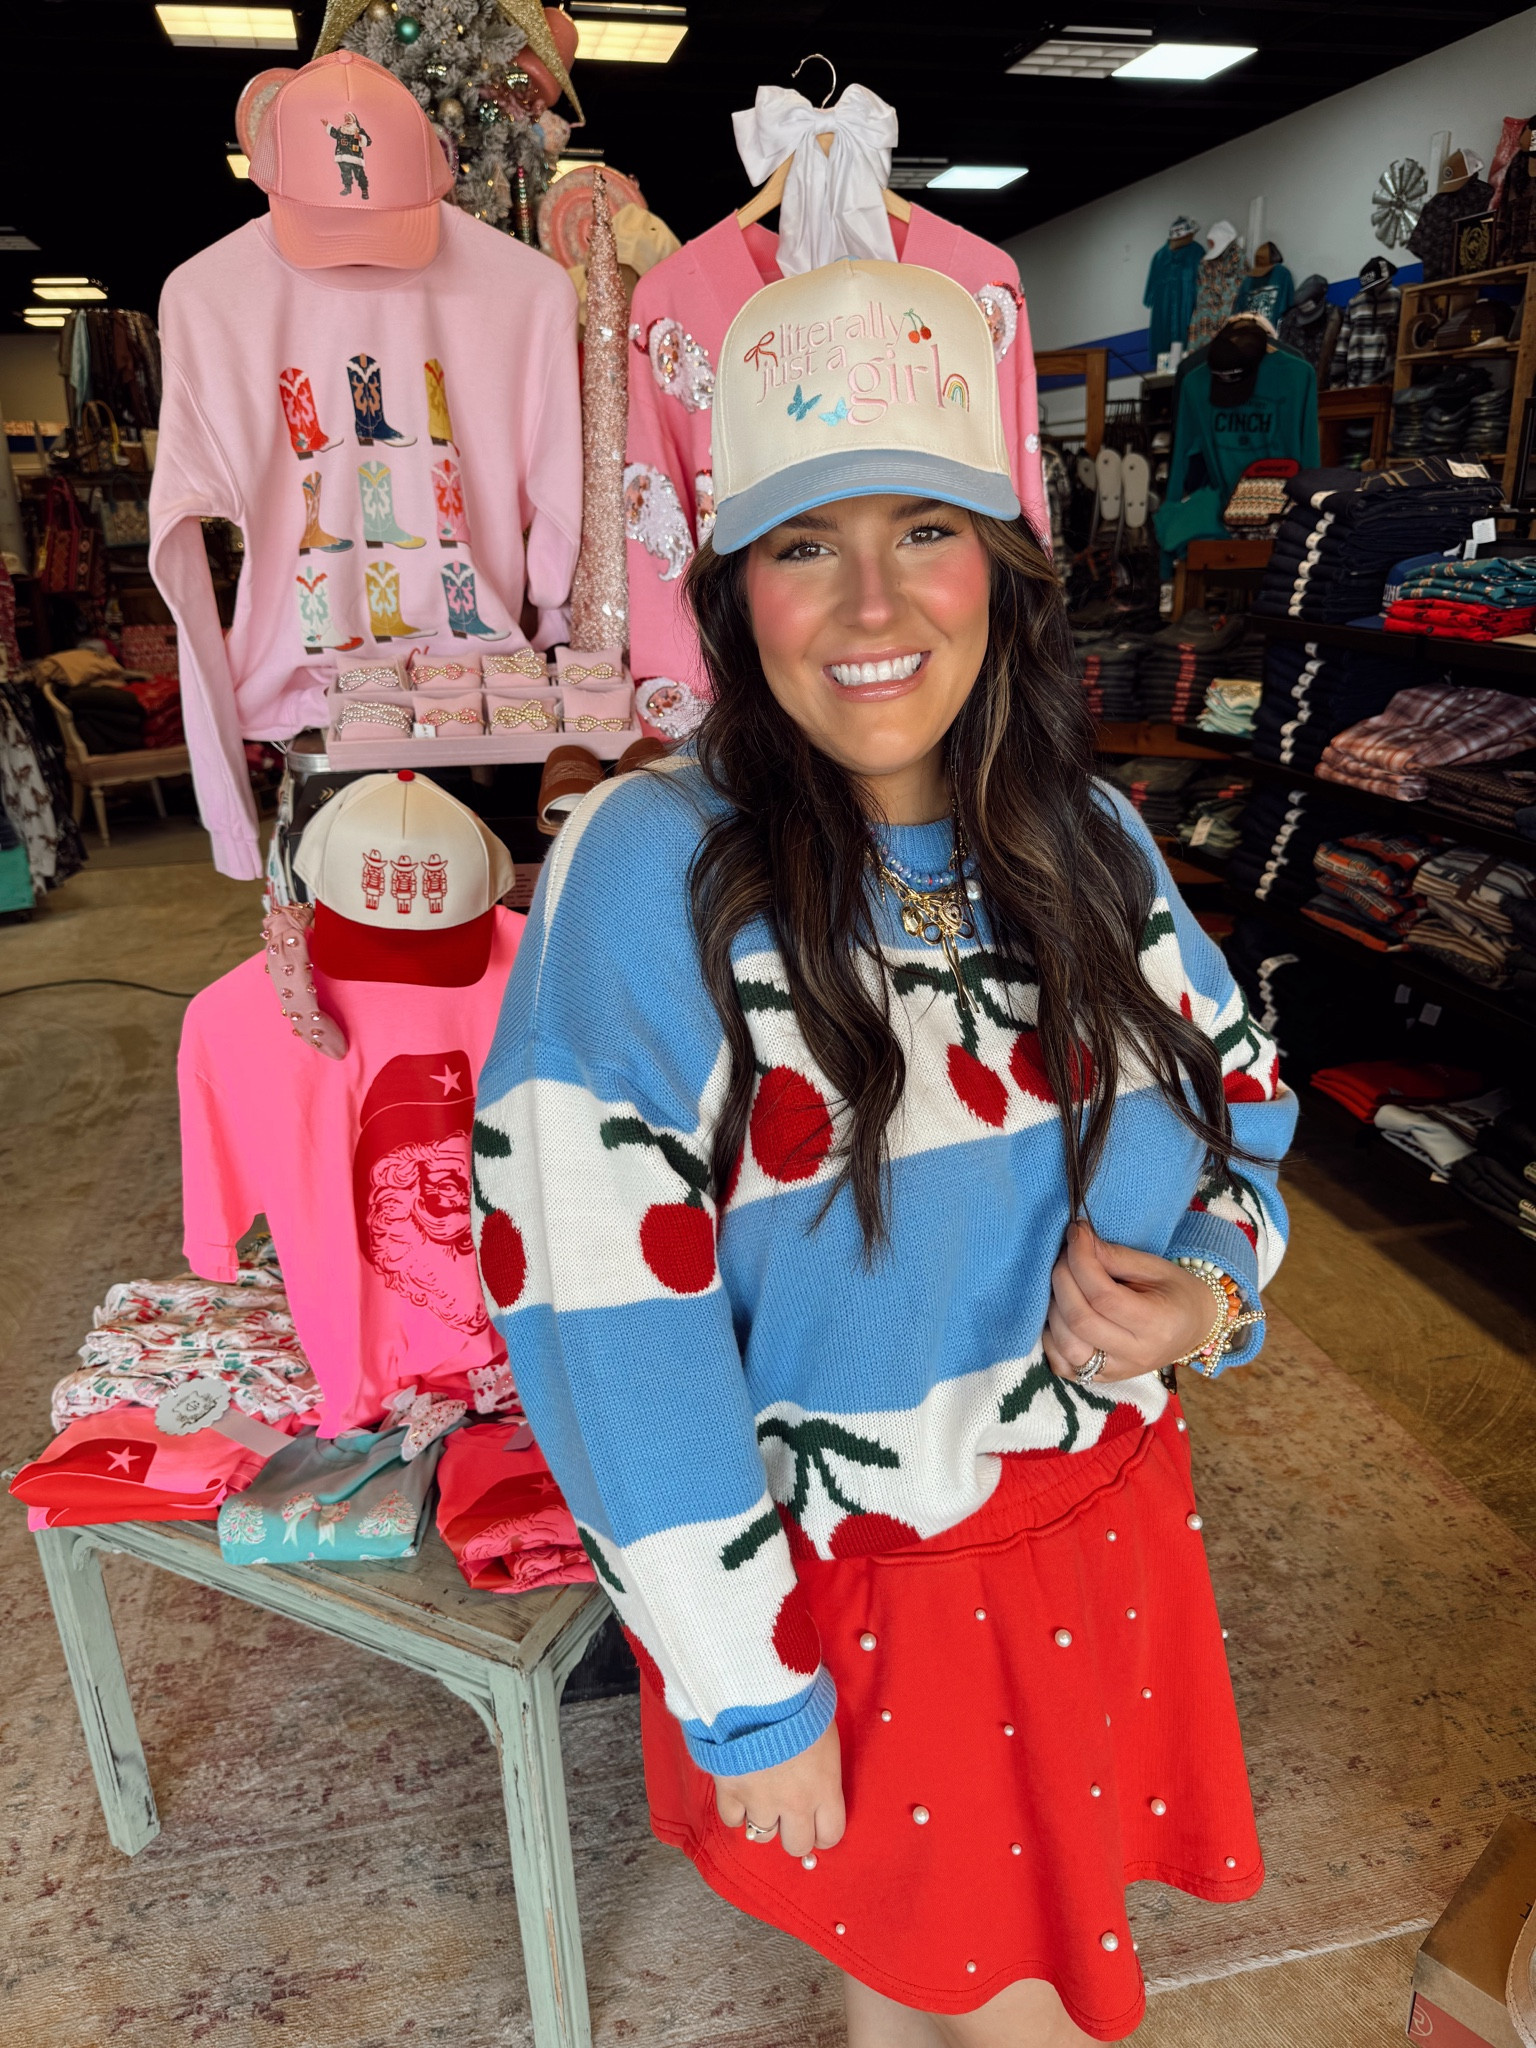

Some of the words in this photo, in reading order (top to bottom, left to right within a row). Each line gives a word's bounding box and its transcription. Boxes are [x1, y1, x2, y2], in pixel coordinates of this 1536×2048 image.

[779, 300, 905, 359] literally
[757, 348, 818, 406] just
[826, 344, 848, 371] a
[846, 343, 947, 426] girl
[1214, 412, 1272, 433] CINCH
